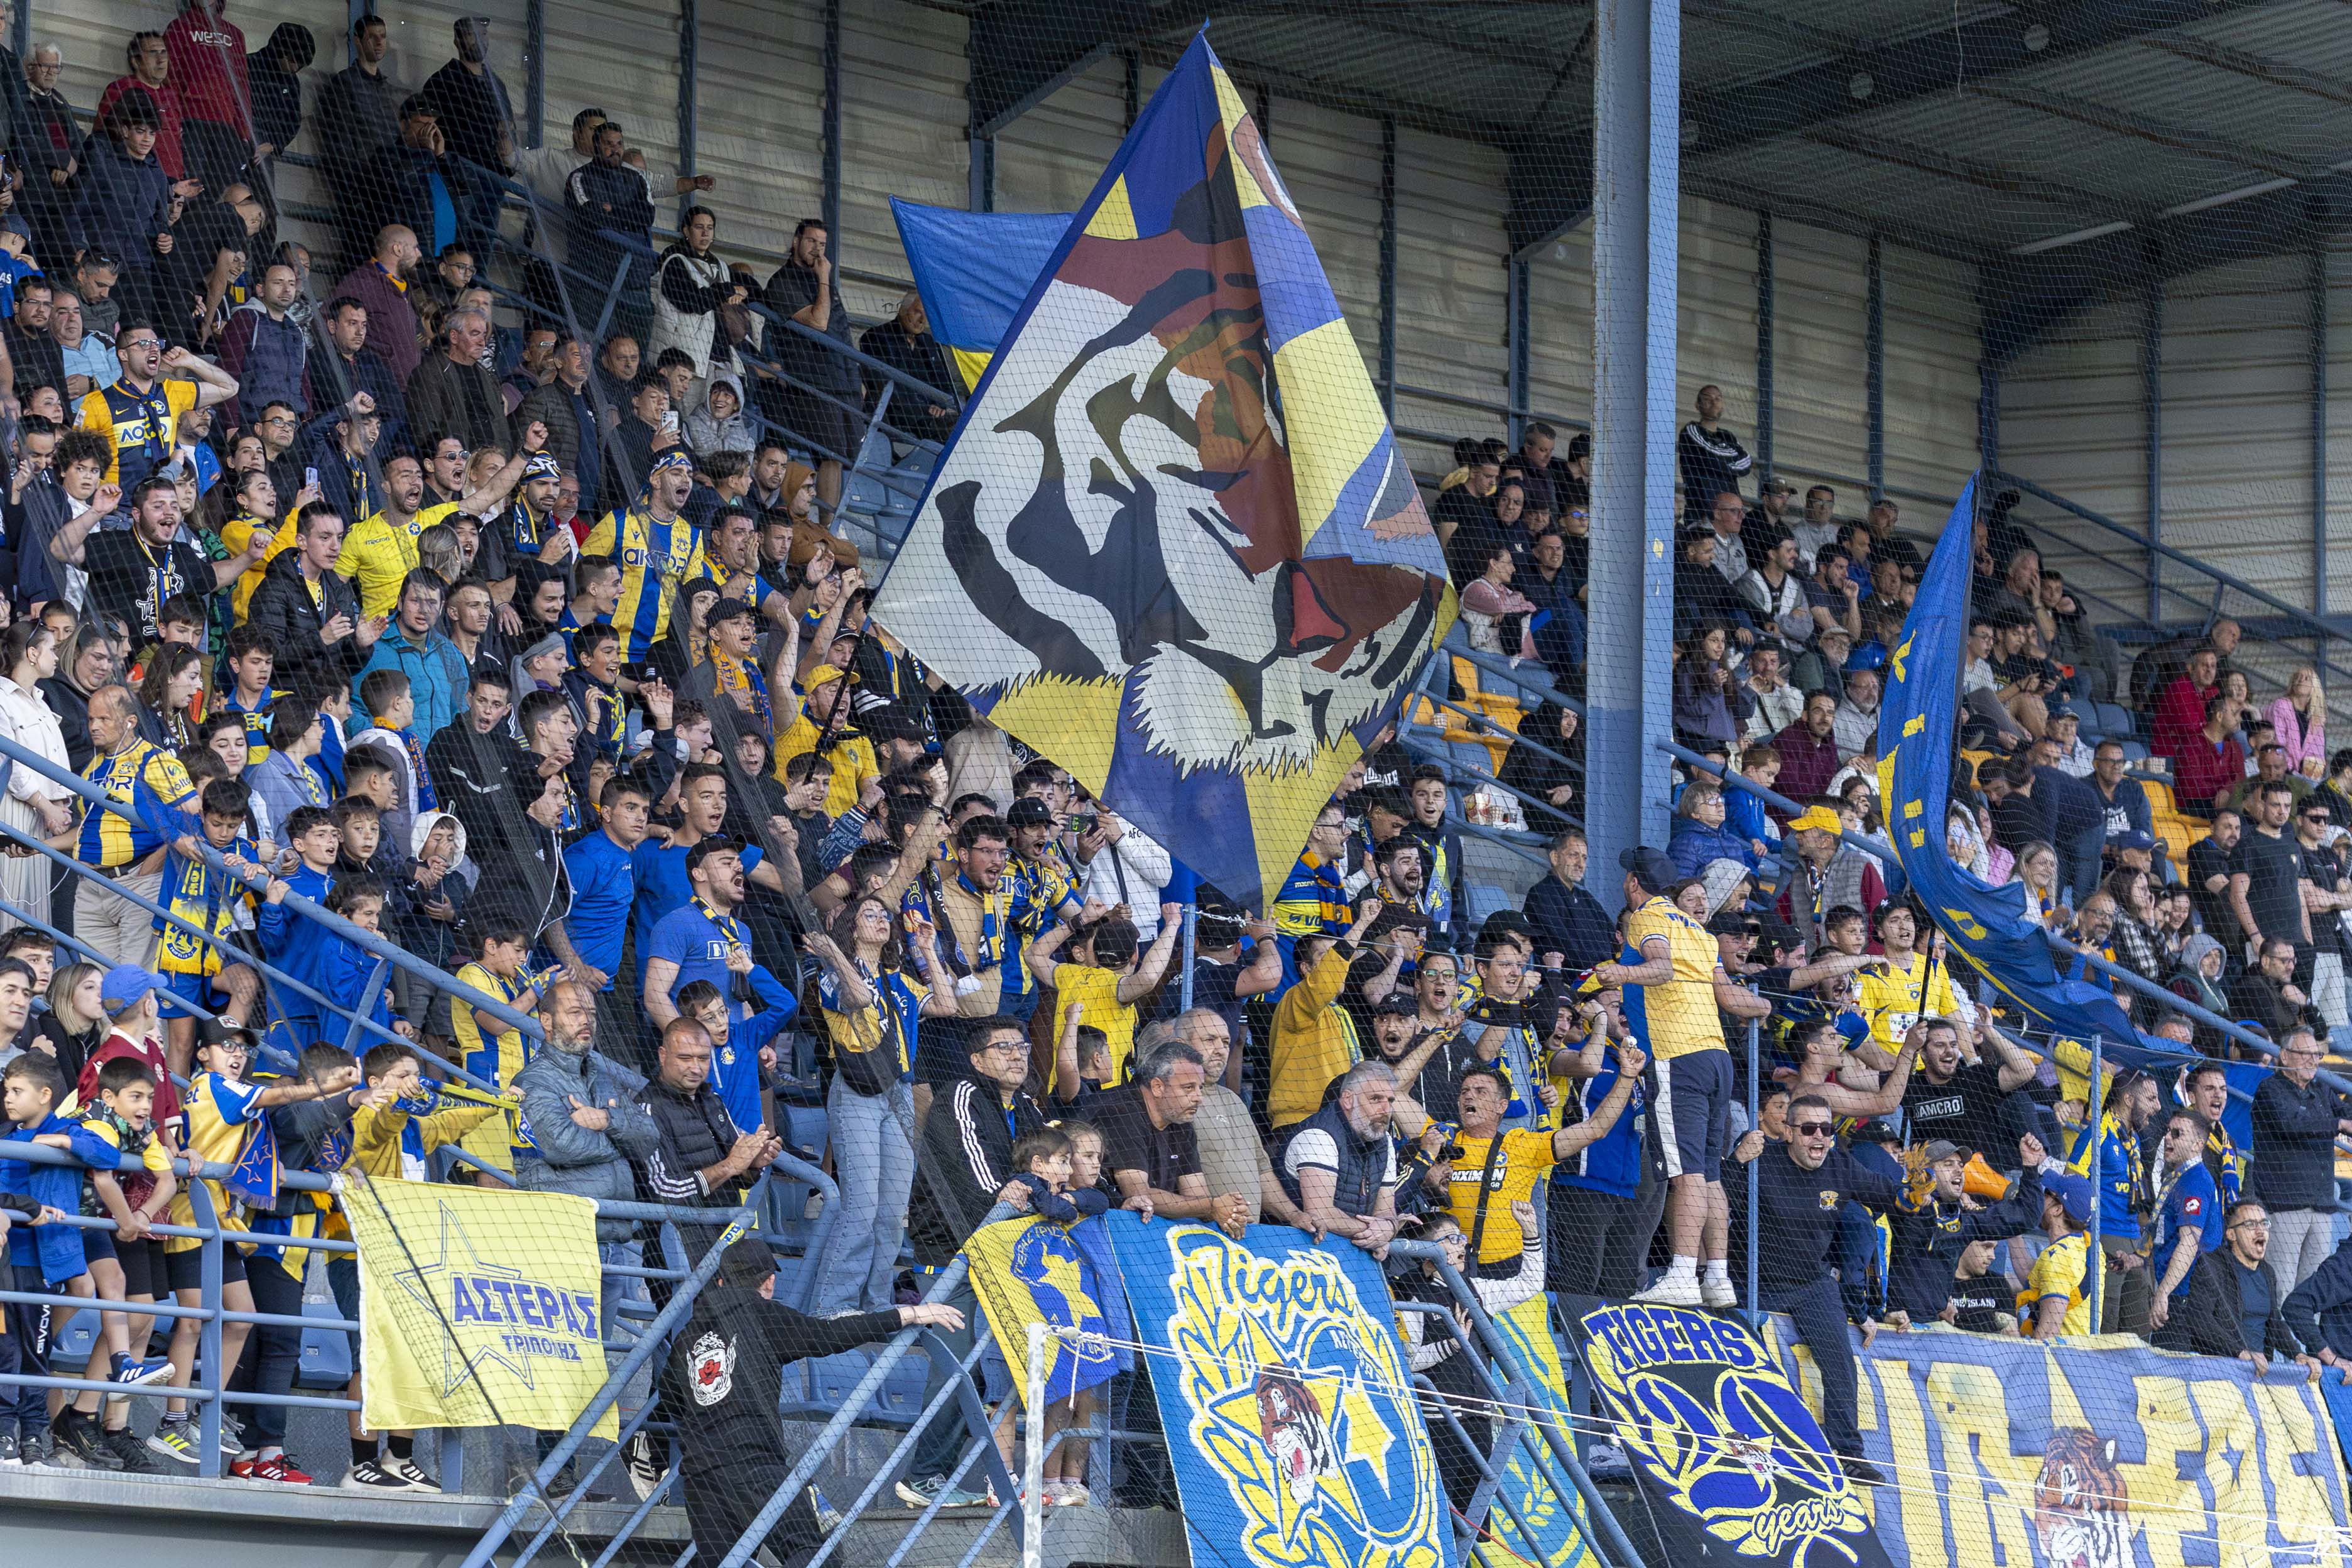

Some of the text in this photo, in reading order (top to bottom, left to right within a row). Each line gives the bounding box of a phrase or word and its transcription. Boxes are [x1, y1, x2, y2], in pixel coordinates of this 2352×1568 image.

[453, 1277, 599, 1339] ΑΣΤΕΡΑΣ
[1966, 1297, 1996, 1309] ISLAND
[1583, 1305, 1763, 1373] TIGERS
[1628, 1371, 1849, 1516] 20
[1751, 1497, 1846, 1554] years
